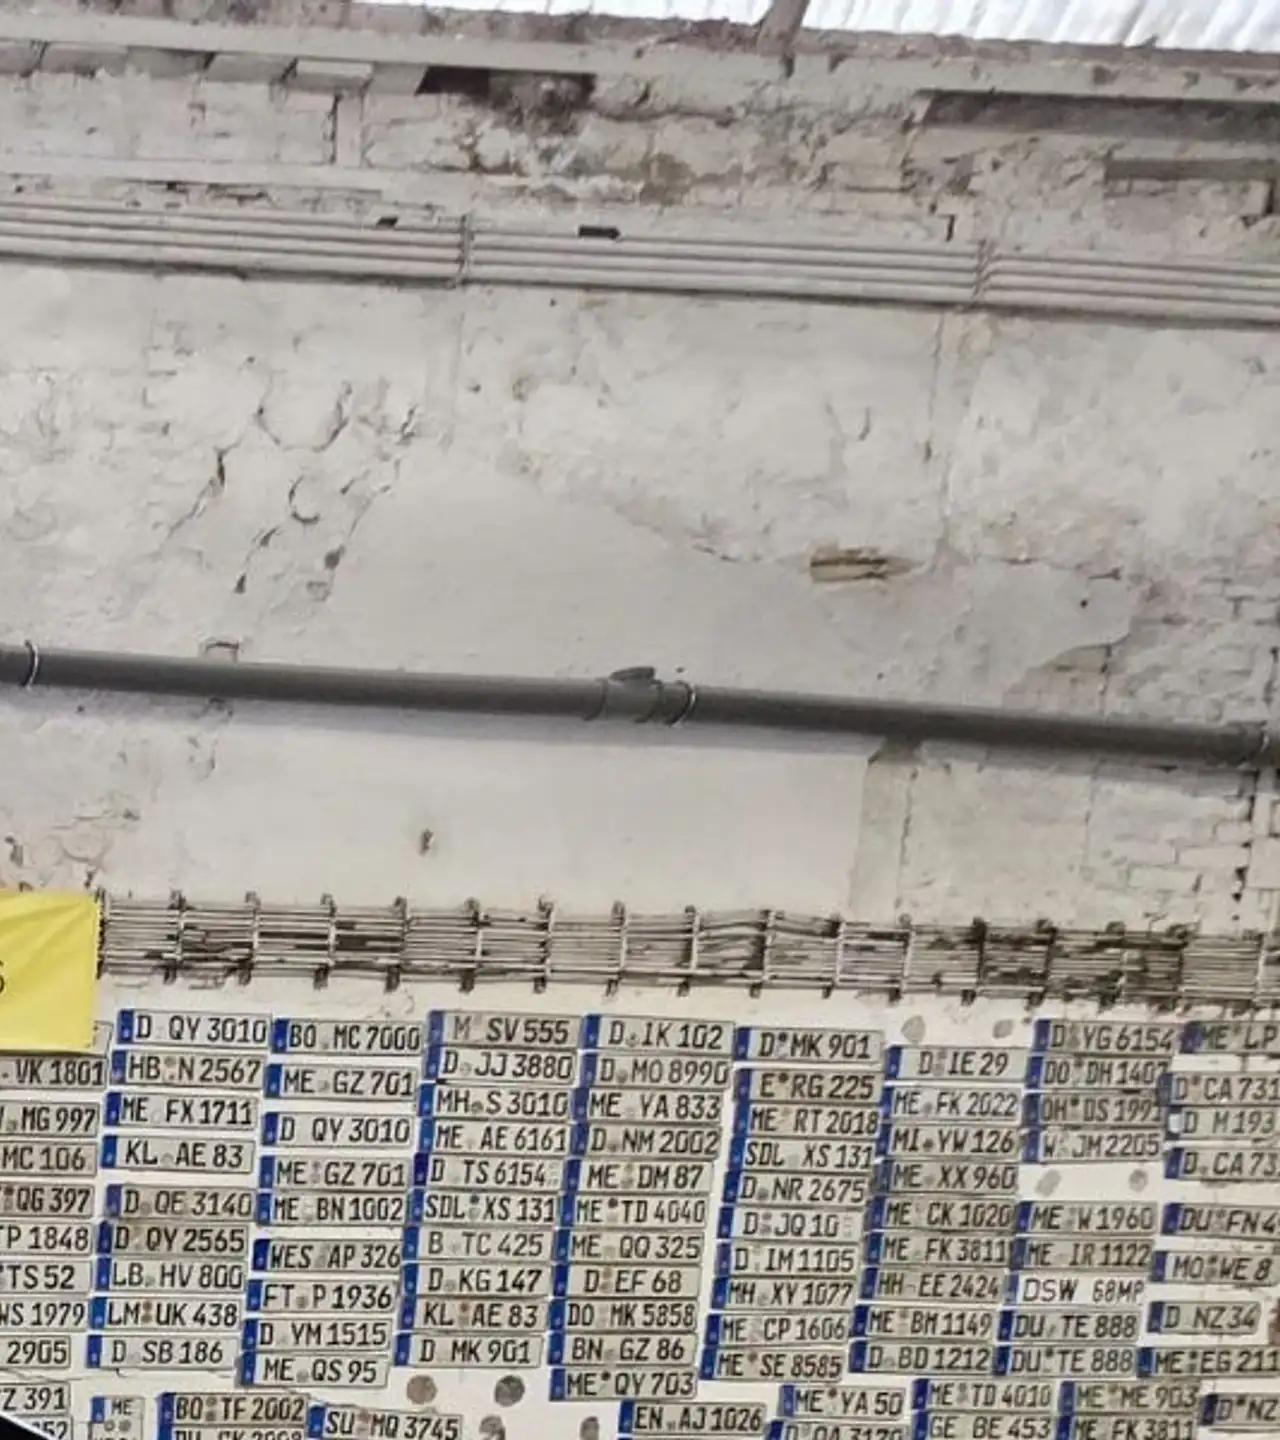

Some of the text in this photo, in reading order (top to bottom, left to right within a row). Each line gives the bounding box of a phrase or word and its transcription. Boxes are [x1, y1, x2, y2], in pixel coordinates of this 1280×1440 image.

[136, 1015, 267, 1043] D QY 3010
[609, 1021, 724, 1049] D IK 102
[444, 1051, 573, 1079] D JJ 3880
[283, 1070, 414, 1097] ME GZ 701
[760, 1073, 875, 1099] E RG 225
[21, 1106, 50, 1131] MG
[56, 1107, 96, 1132] 997
[892, 1127, 1014, 1153] MI YW 126
[1, 1145, 34, 1170] MC
[41, 1147, 86, 1171] 106
[125, 1139, 243, 1168] KL AE 83
[6, 1266, 39, 1290] TS
[43, 1266, 75, 1290] 52
[112, 1262, 242, 1289] LB HV 800
[428, 1268, 543, 1293] D KG 147
[108, 1300, 237, 1327] LM UK 438
[423, 1302, 539, 1328] KL AE 83
[1014, 1314, 1138, 1339] DU TE 888
[7, 1340, 69, 1365] 2905
[112, 1339, 224, 1364] D SB 186
[572, 1338, 685, 1360] BN GZ 86
[567, 1373, 694, 1397] ME QY 703
